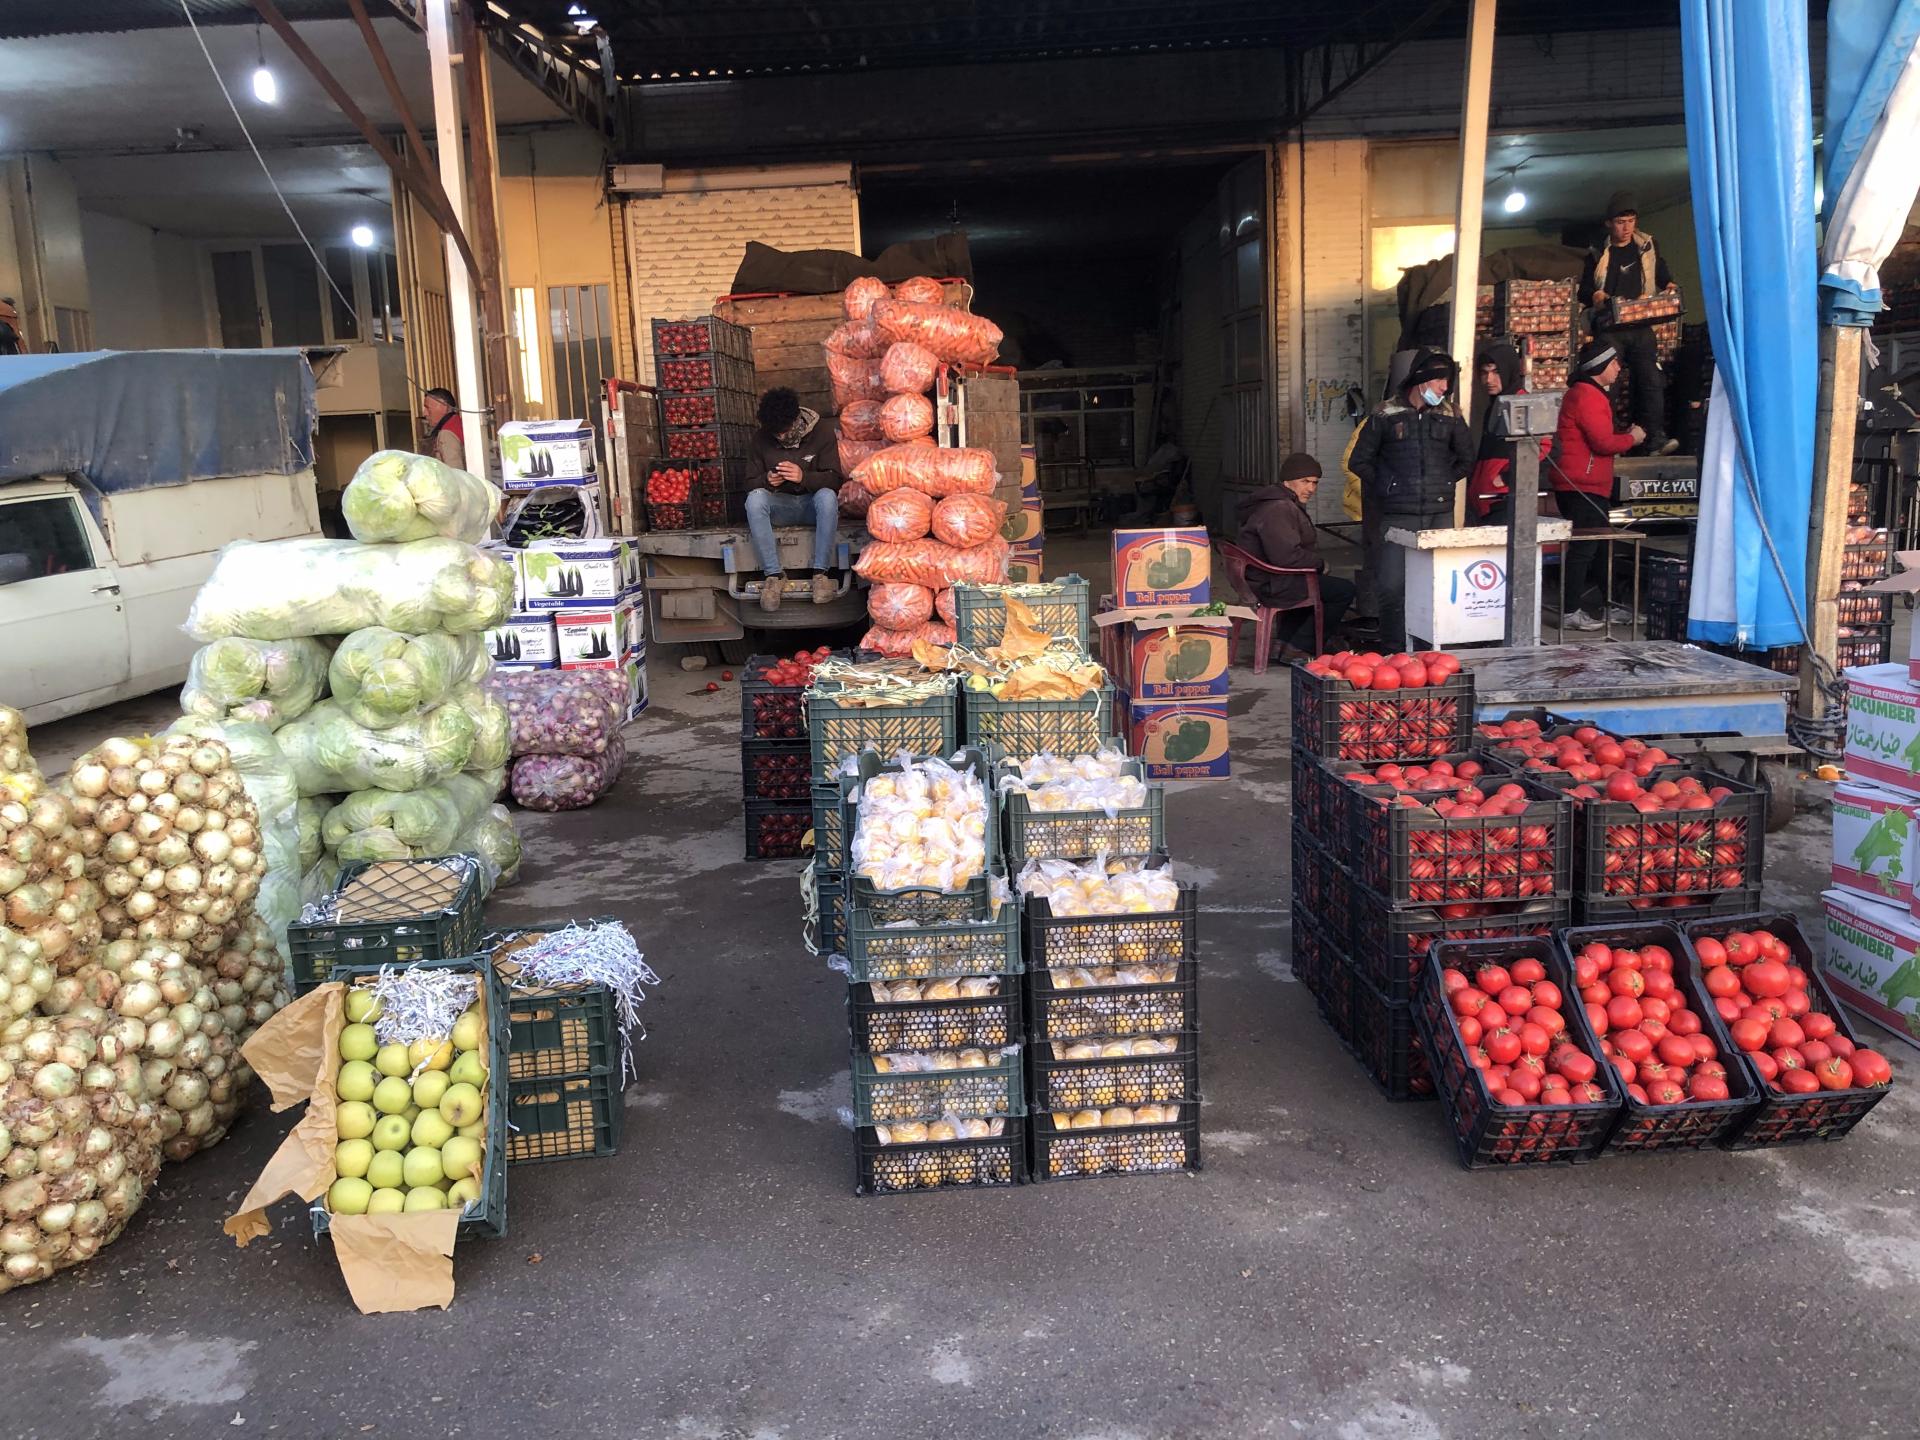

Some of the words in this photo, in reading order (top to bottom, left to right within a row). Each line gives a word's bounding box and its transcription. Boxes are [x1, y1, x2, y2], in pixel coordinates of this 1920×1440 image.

[508, 481, 536, 489] Vegetable
[533, 600, 565, 608] Vegetable
[1135, 591, 1156, 603] Bell
[1156, 592, 1192, 605] pepper
[1153, 683, 1173, 696] Bell
[1174, 685, 1211, 697] pepper
[1872, 689, 1919, 705] GREENHOUSE
[1152, 764, 1173, 776] Bell
[1174, 765, 1211, 778] pepper
[1826, 905, 1853, 925] PREMIUM
[1853, 919, 1897, 944] GREENHOUSE
[1827, 916, 1895, 962] CUCUMBER
